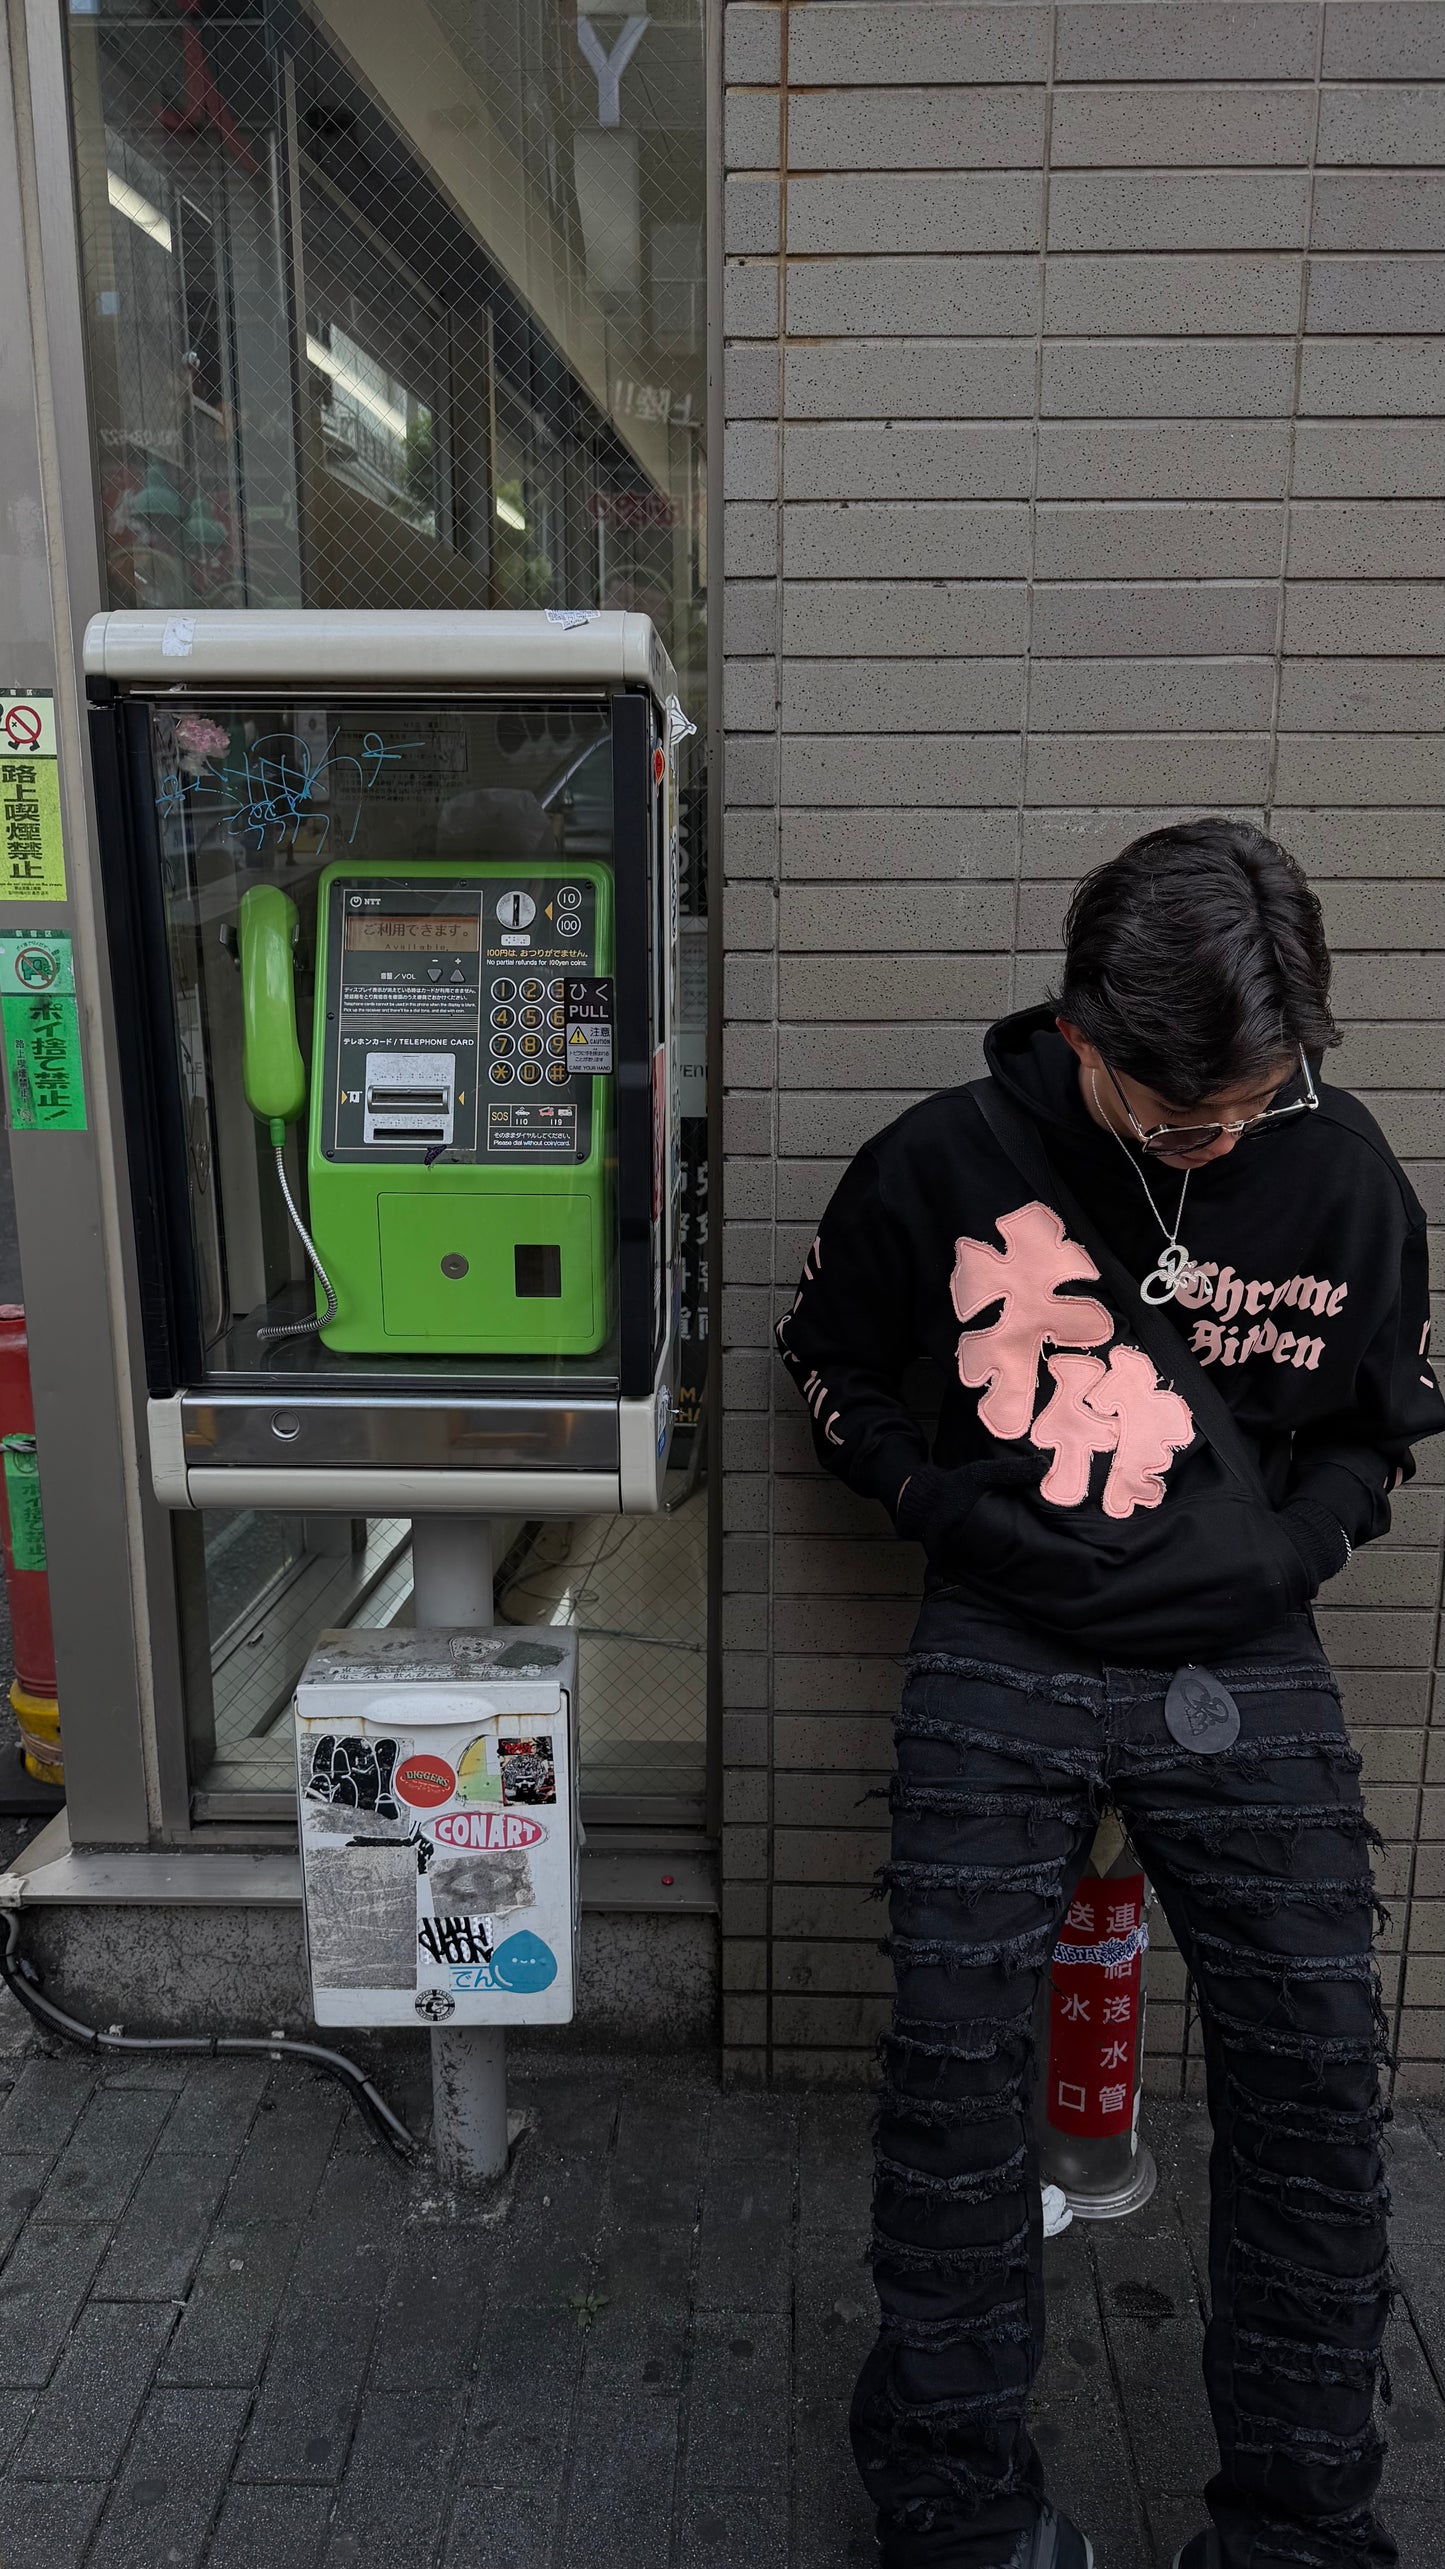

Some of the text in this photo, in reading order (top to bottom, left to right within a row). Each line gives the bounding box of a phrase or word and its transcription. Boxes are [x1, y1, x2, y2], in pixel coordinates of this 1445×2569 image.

[2, 765, 44, 879] 路上喫煙禁止
[563, 893, 576, 904] 10
[364, 923, 469, 937] ご利用できます。
[561, 920, 577, 930] 100
[385, 943, 449, 952] Available.
[486, 949, 588, 957] 100円は、おつりがでません。
[496, 959, 514, 967] partial
[501, 982, 506, 998] 1
[526, 982, 537, 998] 2
[569, 983, 608, 1001] ひく
[496, 1009, 508, 1025] 4
[526, 1009, 536, 1025] 5
[569, 1005, 609, 1018] PULL
[590, 1027, 610, 1037] 注意
[344, 1038, 392, 1046] テレホンカード
[399, 1038, 448, 1046] TELEPHONE
[497, 1037, 508, 1053] 7
[524, 1037, 536, 1053] 8
[30, 1002, 72, 1121] ポイ捨て禁止!
[523, 1064, 535, 1080] 0
[491, 1112, 509, 1121] SOS
[405, 1770, 450, 1787] DIGGERS
[437, 1814, 536, 1848] CONART
[1058, 1900, 1095, 2113] 送水口
